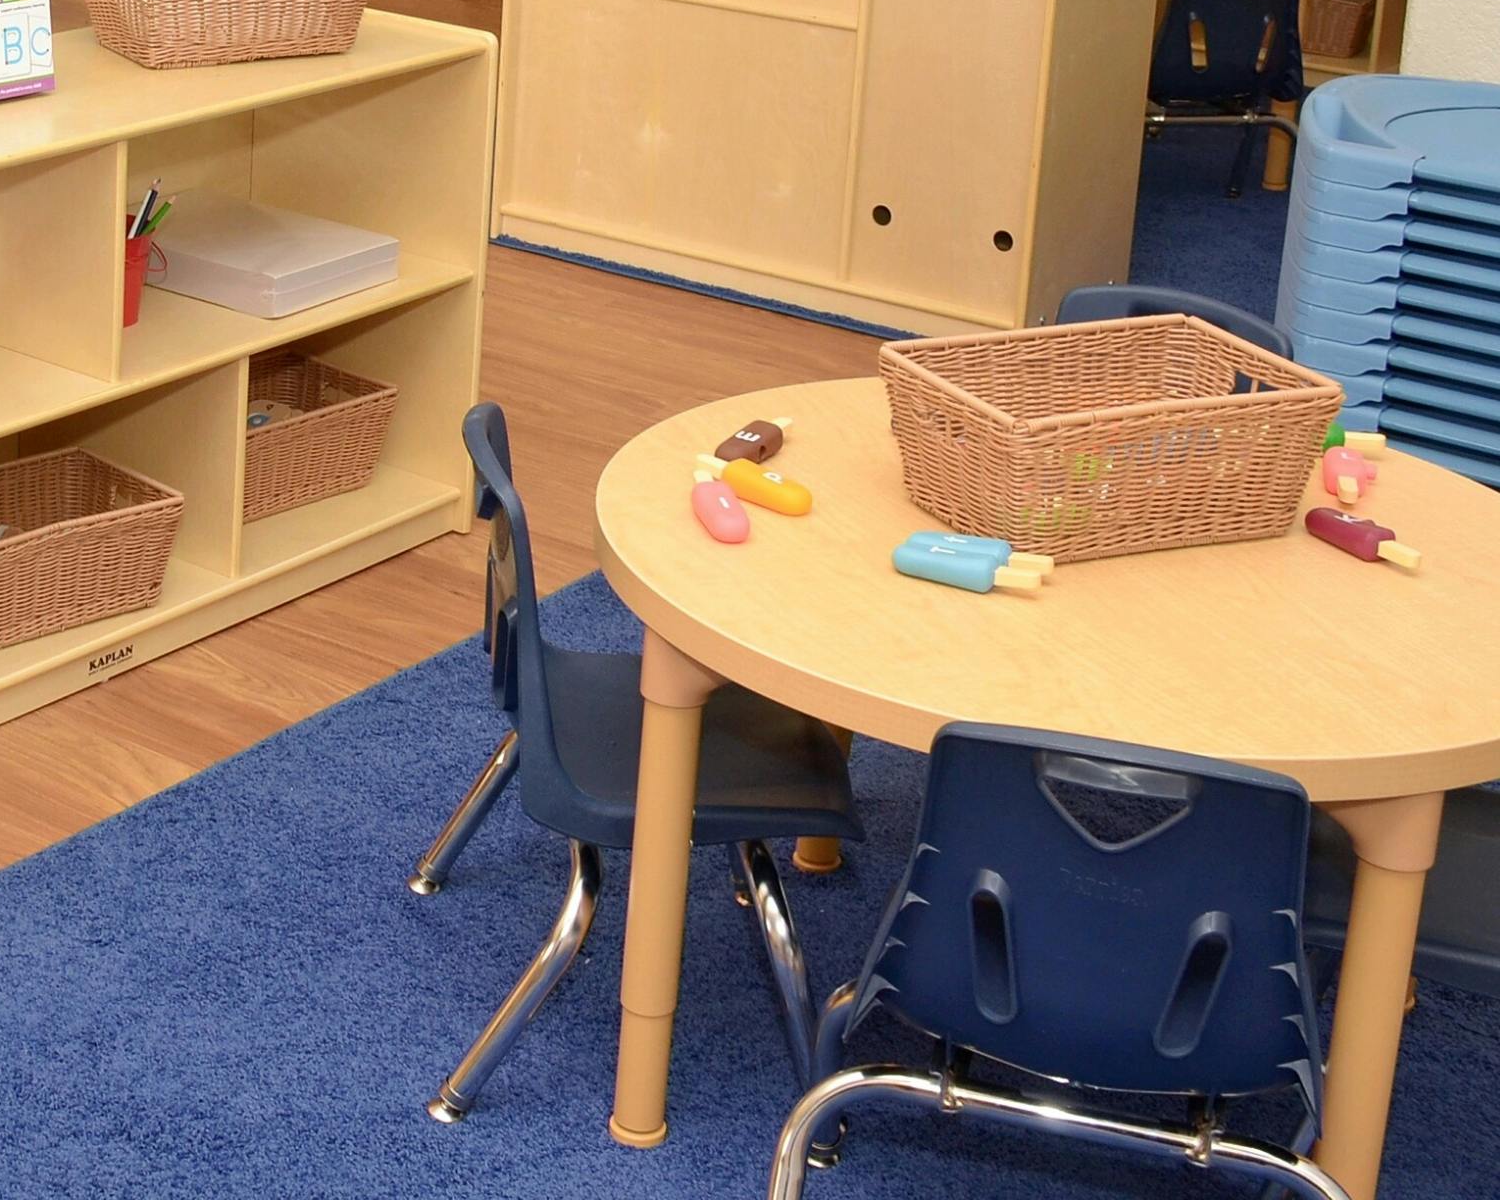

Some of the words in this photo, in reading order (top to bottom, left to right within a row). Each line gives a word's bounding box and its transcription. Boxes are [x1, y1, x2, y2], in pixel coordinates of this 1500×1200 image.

[3, 27, 23, 66] B
[31, 27, 51, 56] C
[88, 644, 134, 672] KAPLAN
